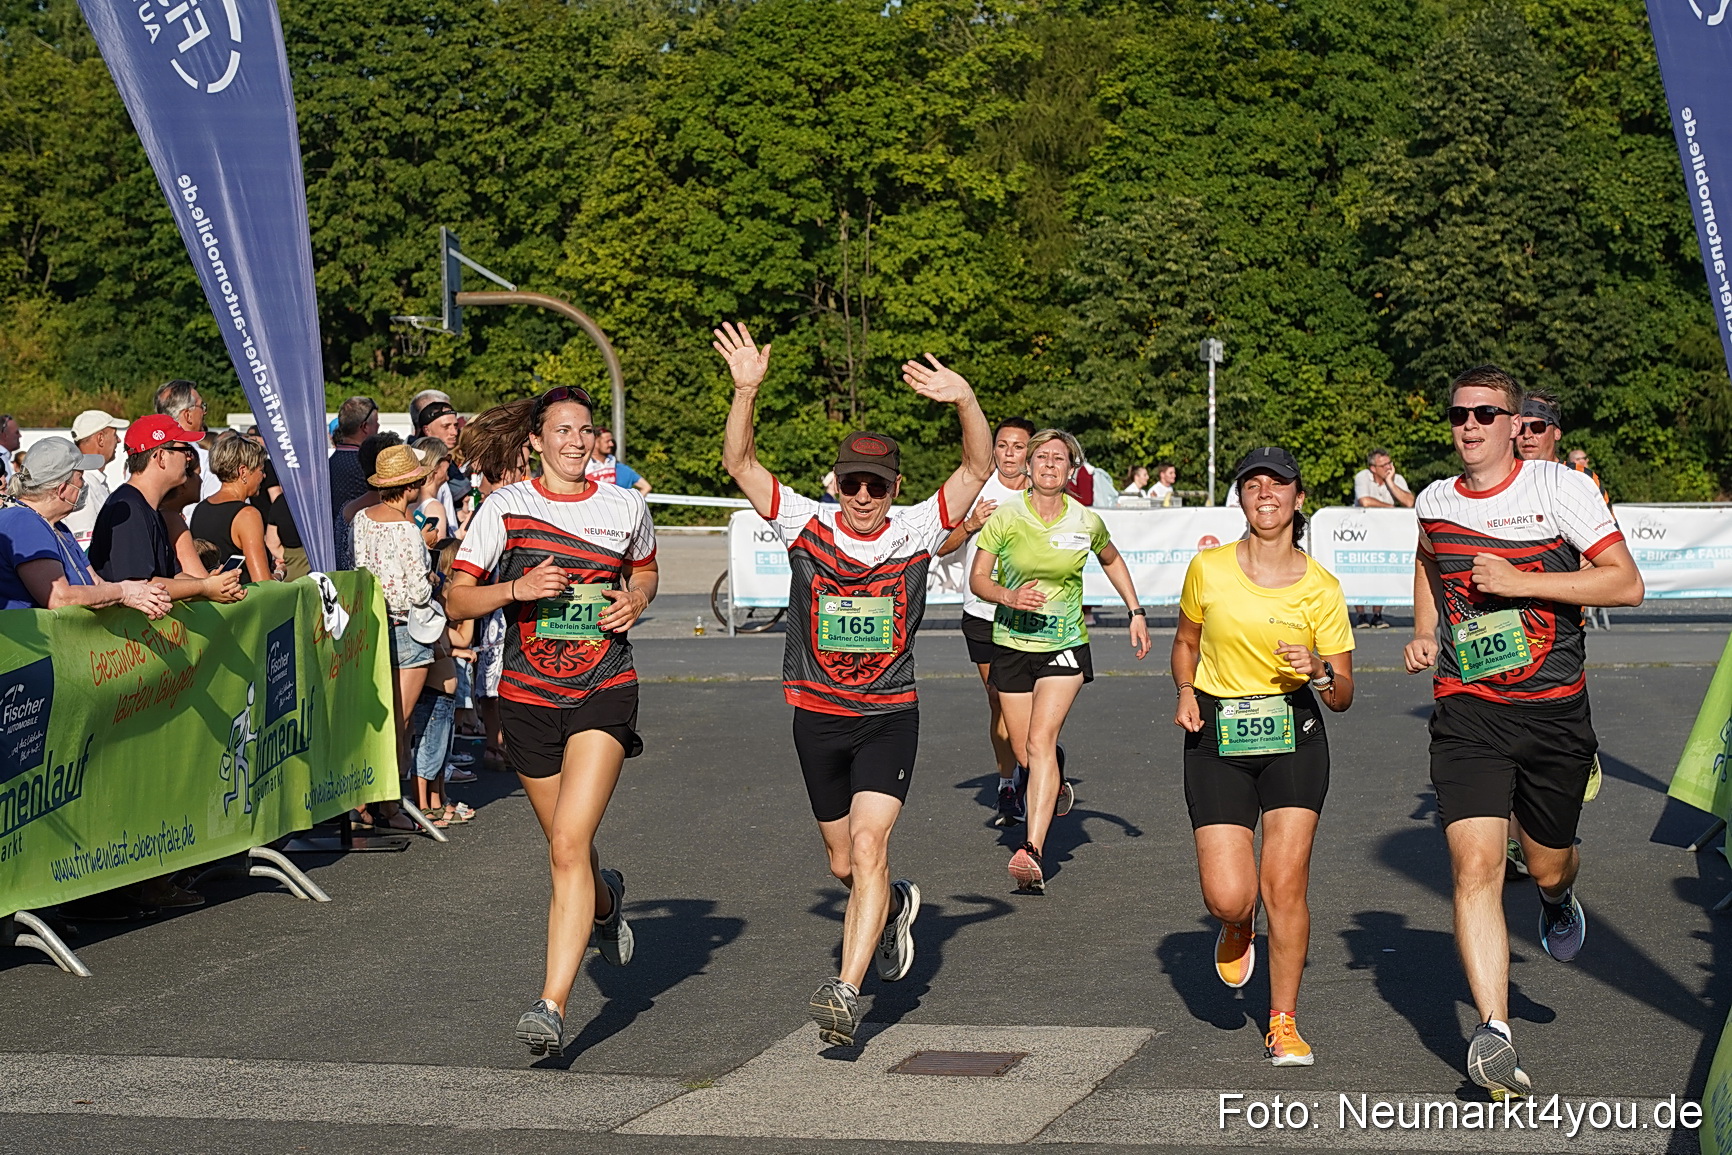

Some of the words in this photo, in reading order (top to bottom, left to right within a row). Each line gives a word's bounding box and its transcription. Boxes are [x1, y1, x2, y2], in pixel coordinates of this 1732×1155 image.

[1486, 515, 1534, 528] NEUMARKT
[584, 527, 624, 538] NEUMARKT
[1333, 529, 1367, 541] NOW
[1631, 527, 1667, 540] NOW
[1336, 552, 1385, 563] E-BIKES
[1388, 552, 1398, 563] &
[1634, 549, 1682, 561] E-BIKES
[1686, 548, 1695, 560] &
[541, 607, 549, 627] RUN
[560, 603, 593, 622] 121
[837, 616, 875, 635] 165
[882, 619, 890, 644] 2022
[1057, 618, 1065, 637] 2022
[828, 634, 852, 642] Gärtner
[1470, 633, 1507, 658] 126
[1512, 630, 1527, 658] 2022
[90, 627, 147, 687] Gesunde
[141, 621, 189, 660] Firmen
[270, 651, 290, 676] Fischer
[1459, 650, 1470, 671] RUN
[1468, 660, 1484, 670] Seger
[1485, 650, 1519, 665] Alexander
[113, 675, 154, 725] laufen
[154, 648, 203, 708] länger!
[3, 697, 45, 725] Fischer
[6, 716, 38, 735] AUTOMOBILE
[1221, 725, 1230, 745] RUN
[1236, 717, 1275, 737] 559
[1283, 718, 1292, 745] 2022
[50, 814, 196, 883] www.firmenlauf-oberpfalz.de
